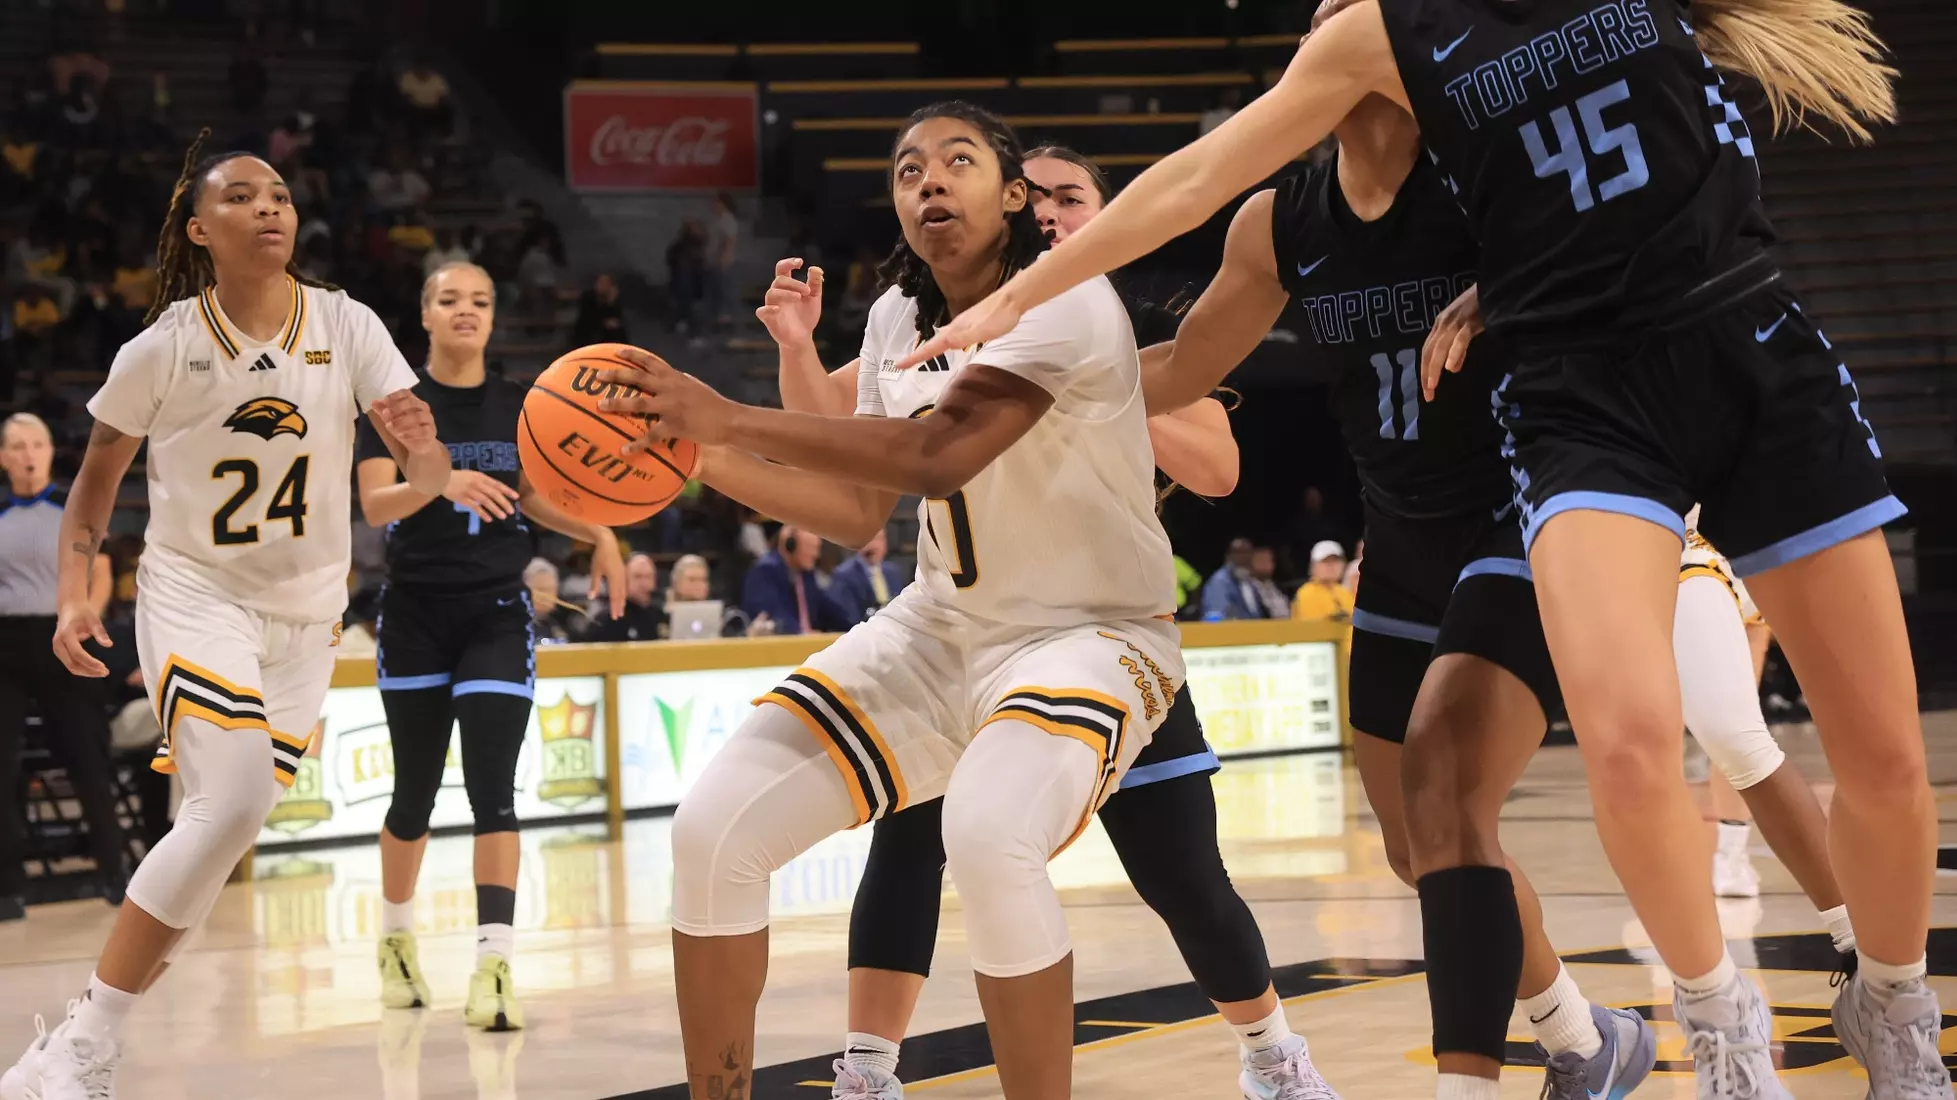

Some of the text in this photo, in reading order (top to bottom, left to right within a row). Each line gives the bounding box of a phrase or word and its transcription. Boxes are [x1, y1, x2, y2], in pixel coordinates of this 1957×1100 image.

[1445, 0, 1658, 130] TOPPERS
[1518, 79, 1650, 212] 45
[1302, 271, 1480, 344] TOPPER
[1369, 348, 1419, 440] 11
[211, 453, 310, 546] 24
[445, 441, 517, 471] PPERS
[557, 431, 633, 483] EVO
